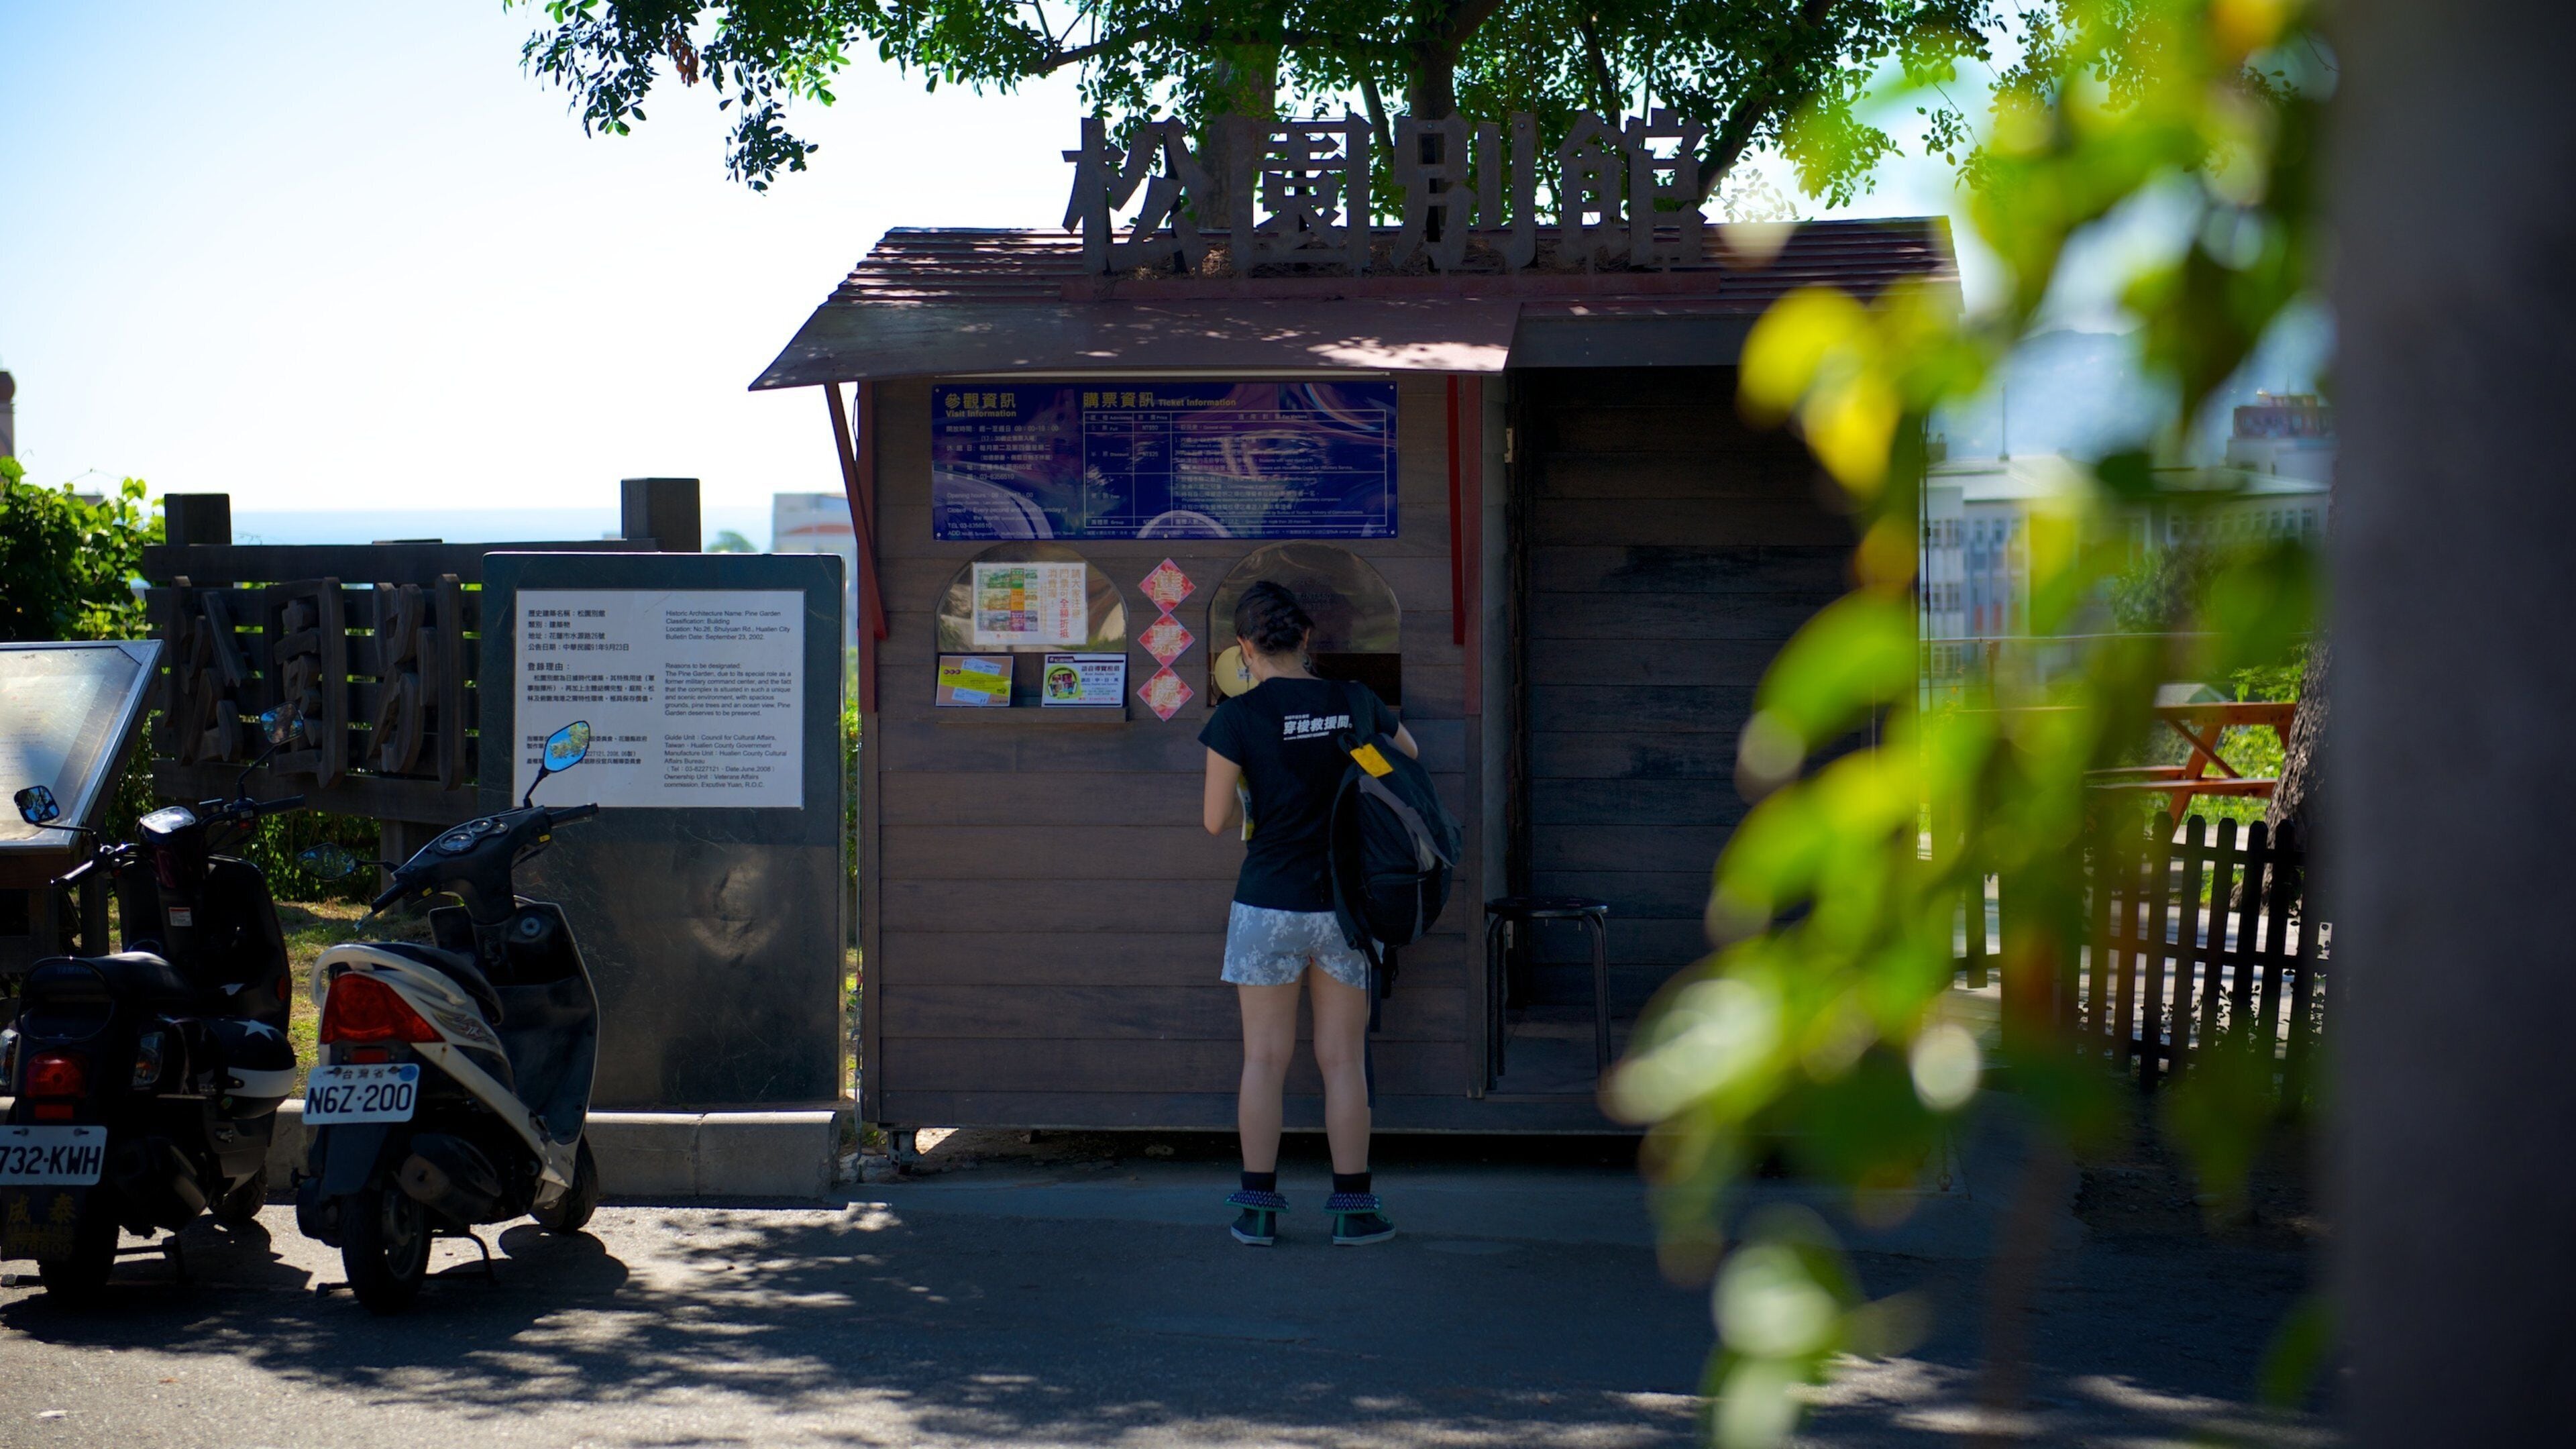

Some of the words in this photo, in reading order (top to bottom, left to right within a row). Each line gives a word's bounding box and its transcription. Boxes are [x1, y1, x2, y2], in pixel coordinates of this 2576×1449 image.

[1061, 109, 1708, 275] 松園別館
[945, 392, 1016, 409] 參觀資訊
[1083, 392, 1155, 408] 購票資訊
[1187, 398, 1236, 407] Information
[1150, 570, 1184, 708] 售票處
